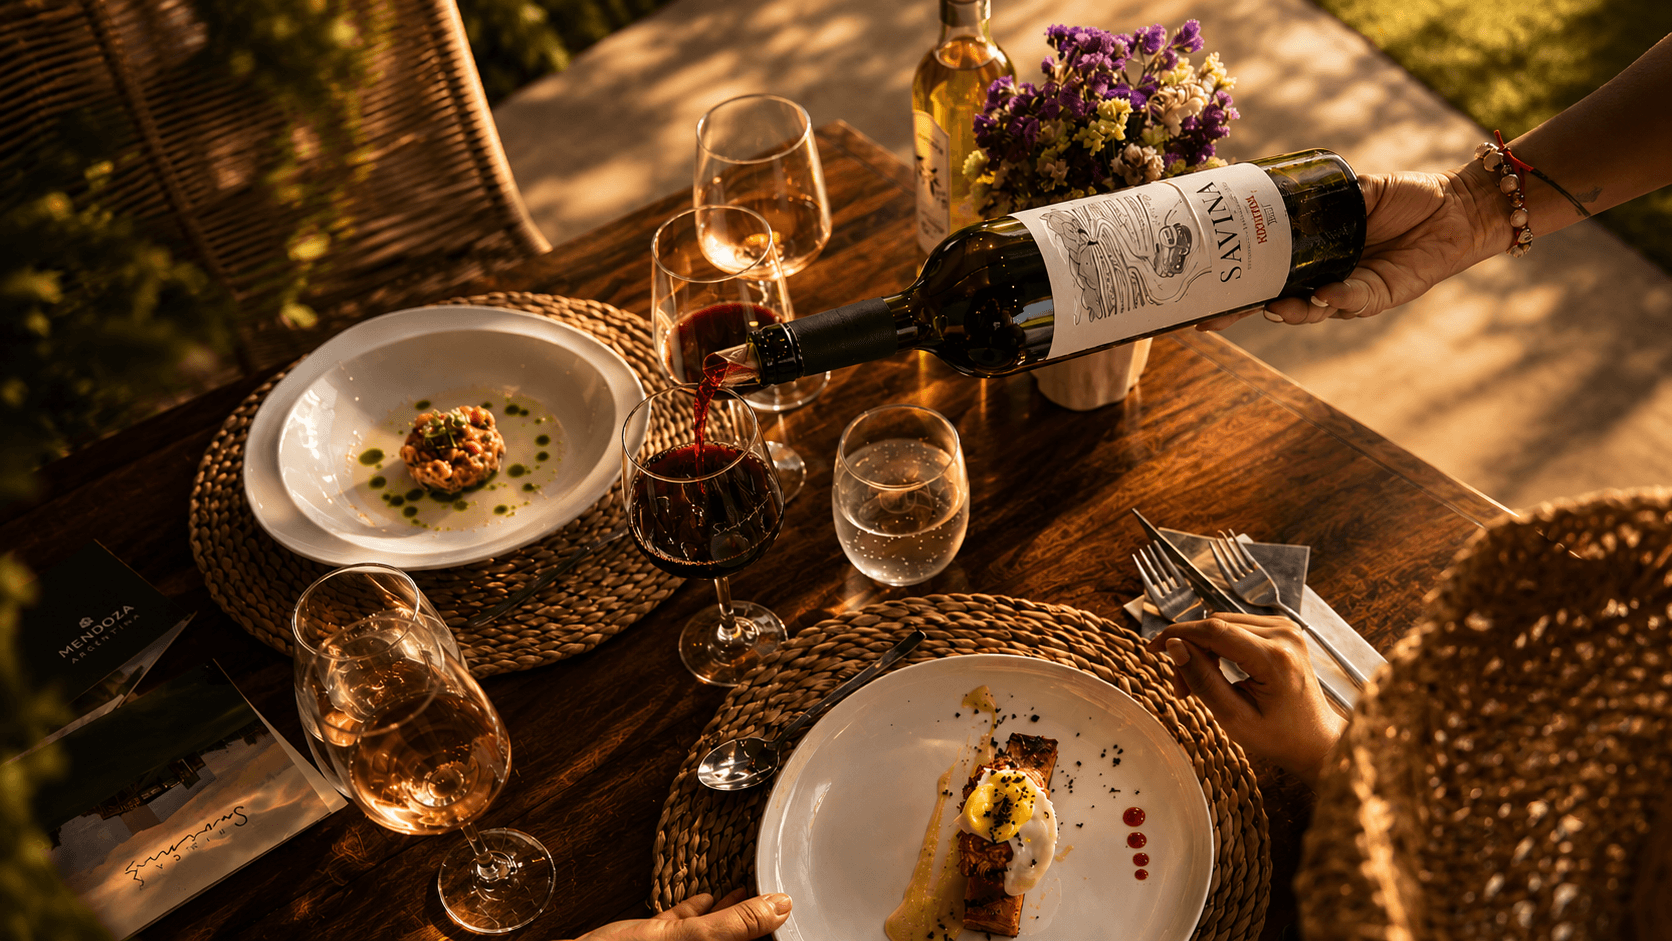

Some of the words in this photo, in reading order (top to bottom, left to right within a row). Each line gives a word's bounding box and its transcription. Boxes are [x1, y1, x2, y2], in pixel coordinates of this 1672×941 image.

[1196, 181, 1242, 282] SAVINA
[58, 605, 135, 658] MENDOZA
[71, 614, 140, 664] ARGENTINA
